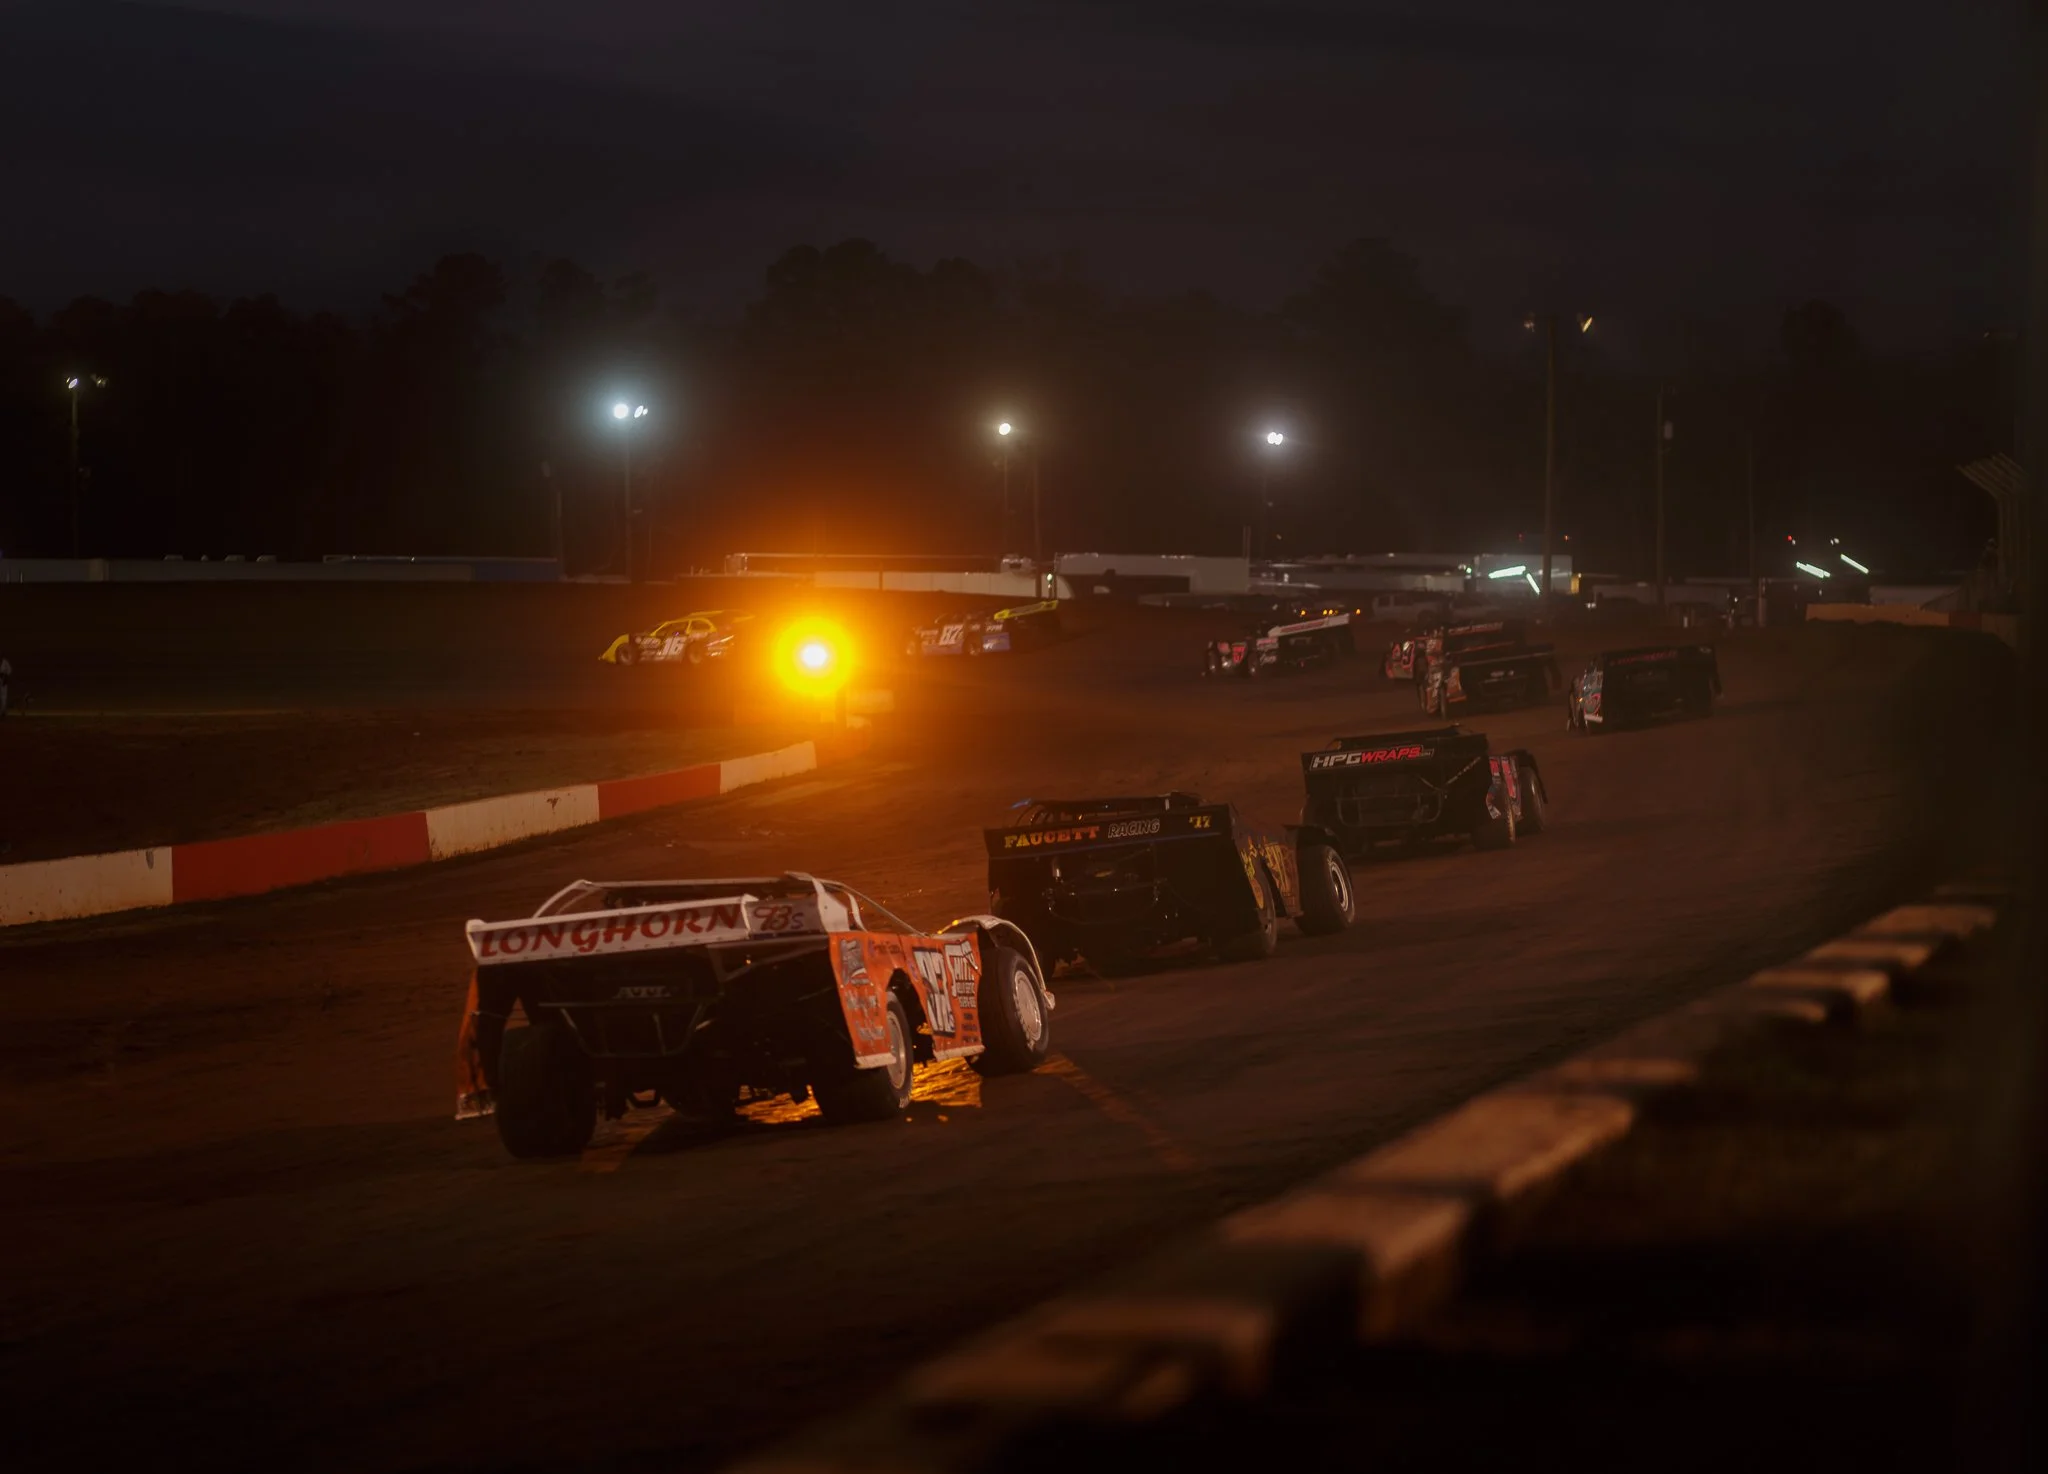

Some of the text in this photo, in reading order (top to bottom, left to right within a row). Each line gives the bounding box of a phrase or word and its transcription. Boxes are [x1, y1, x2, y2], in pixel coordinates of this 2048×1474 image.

[1004, 826, 1100, 848] FAUCETT
[1108, 818, 1160, 838] RACING
[480, 904, 742, 958] LONGHORN
